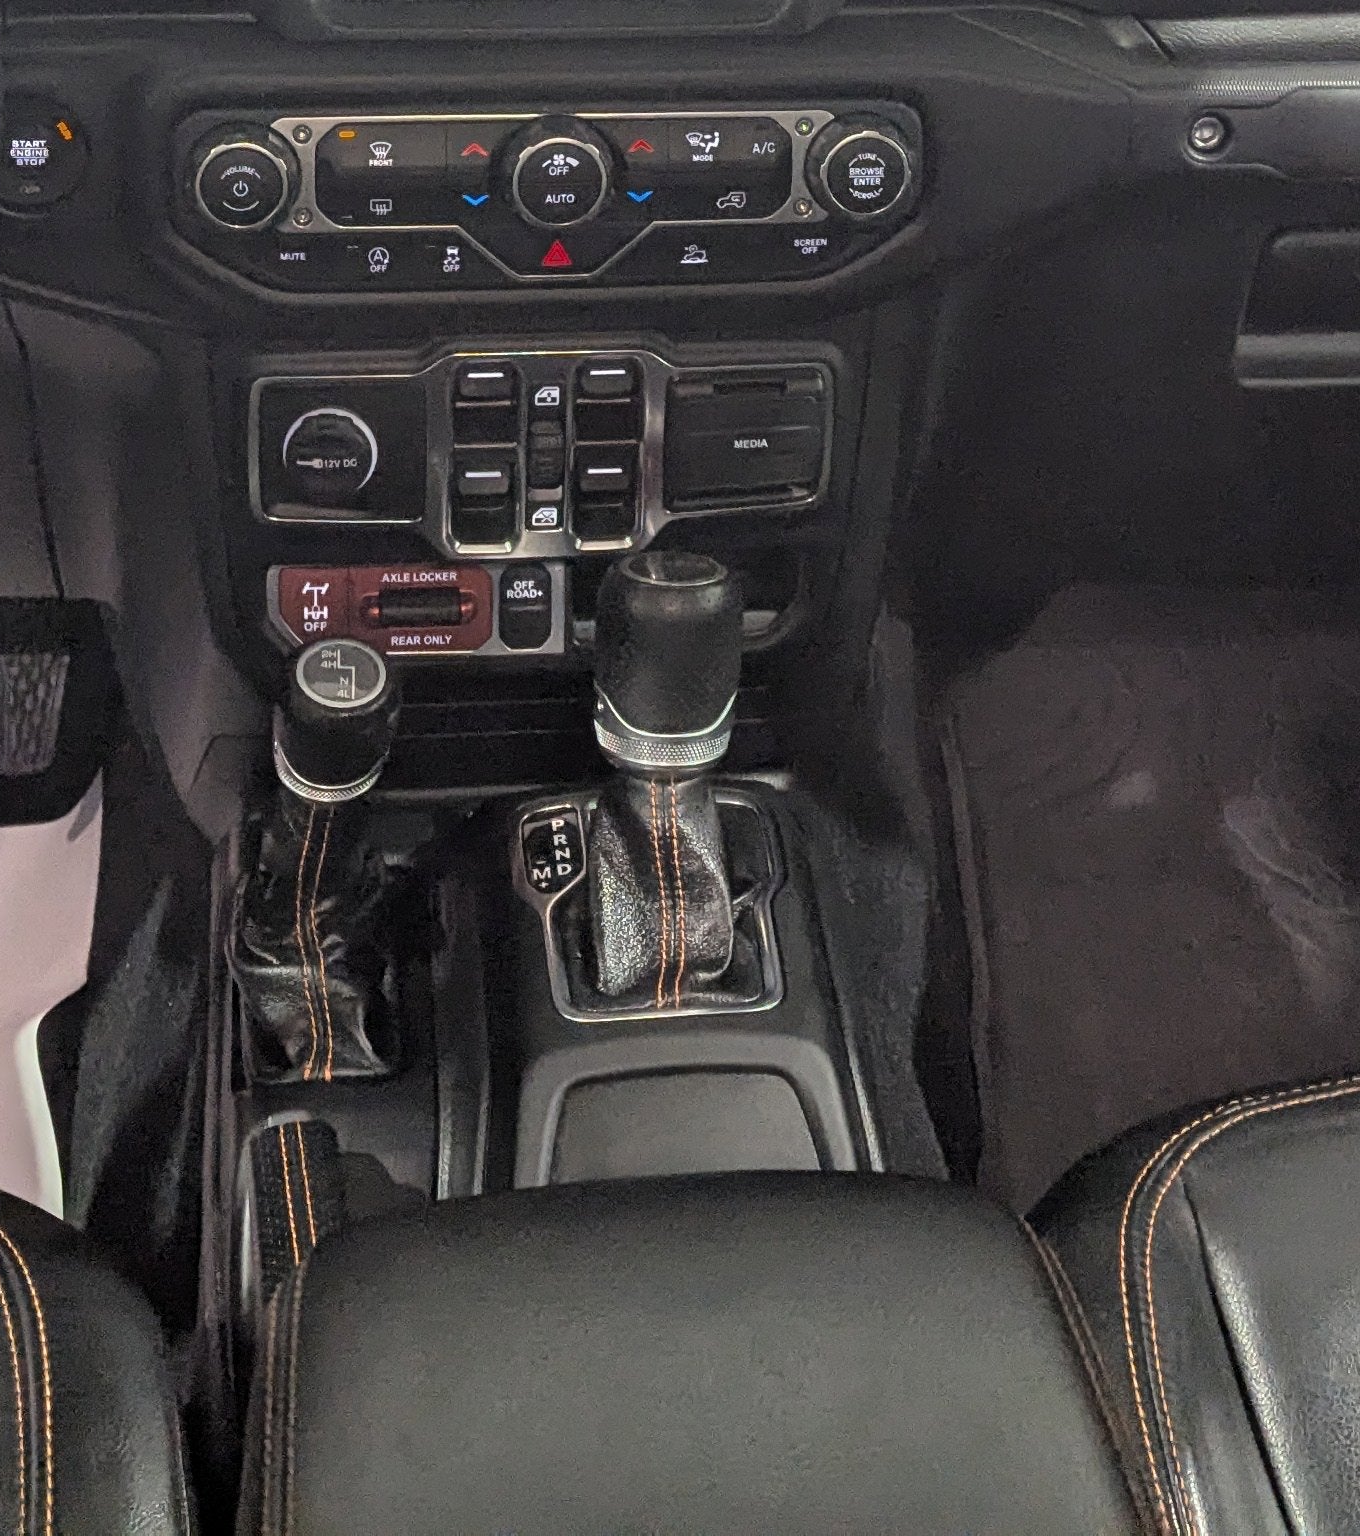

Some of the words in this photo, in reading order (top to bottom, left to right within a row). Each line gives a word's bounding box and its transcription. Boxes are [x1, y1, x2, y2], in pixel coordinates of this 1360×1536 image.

[11, 139, 47, 148] START
[9, 149, 50, 157] ENGINE
[752, 142, 776, 155] A/C
[15, 158, 46, 166] STOP
[368, 158, 393, 167] FRONT
[692, 154, 714, 162] MODE
[224, 164, 256, 177] VOLUME
[548, 165, 570, 176] OFF
[849, 167, 885, 176] BROWSE
[853, 177, 881, 186] ENTER
[544, 193, 576, 204] AUTO
[852, 190, 881, 200] SCROLL
[793, 238, 828, 247] SCREEN
[801, 246, 819, 255] OFF
[280, 252, 306, 261] MUTE
[370, 263, 387, 272] OFF
[443, 263, 460, 272] OFF
[734, 437, 768, 449] MEDIA
[324, 459, 341, 468] 12V
[342, 458, 358, 468] DC
[382, 572, 411, 583] AXLE
[413, 572, 457, 583] LOCKER
[513, 580, 535, 590] OFF
[303, 621, 328, 632] OFF
[391, 635, 421, 646] REAR
[424, 634, 453, 646] ONLY
[320, 660, 338, 669] 4H
[340, 676, 350, 686] N
[337, 688, 351, 698] 4L
